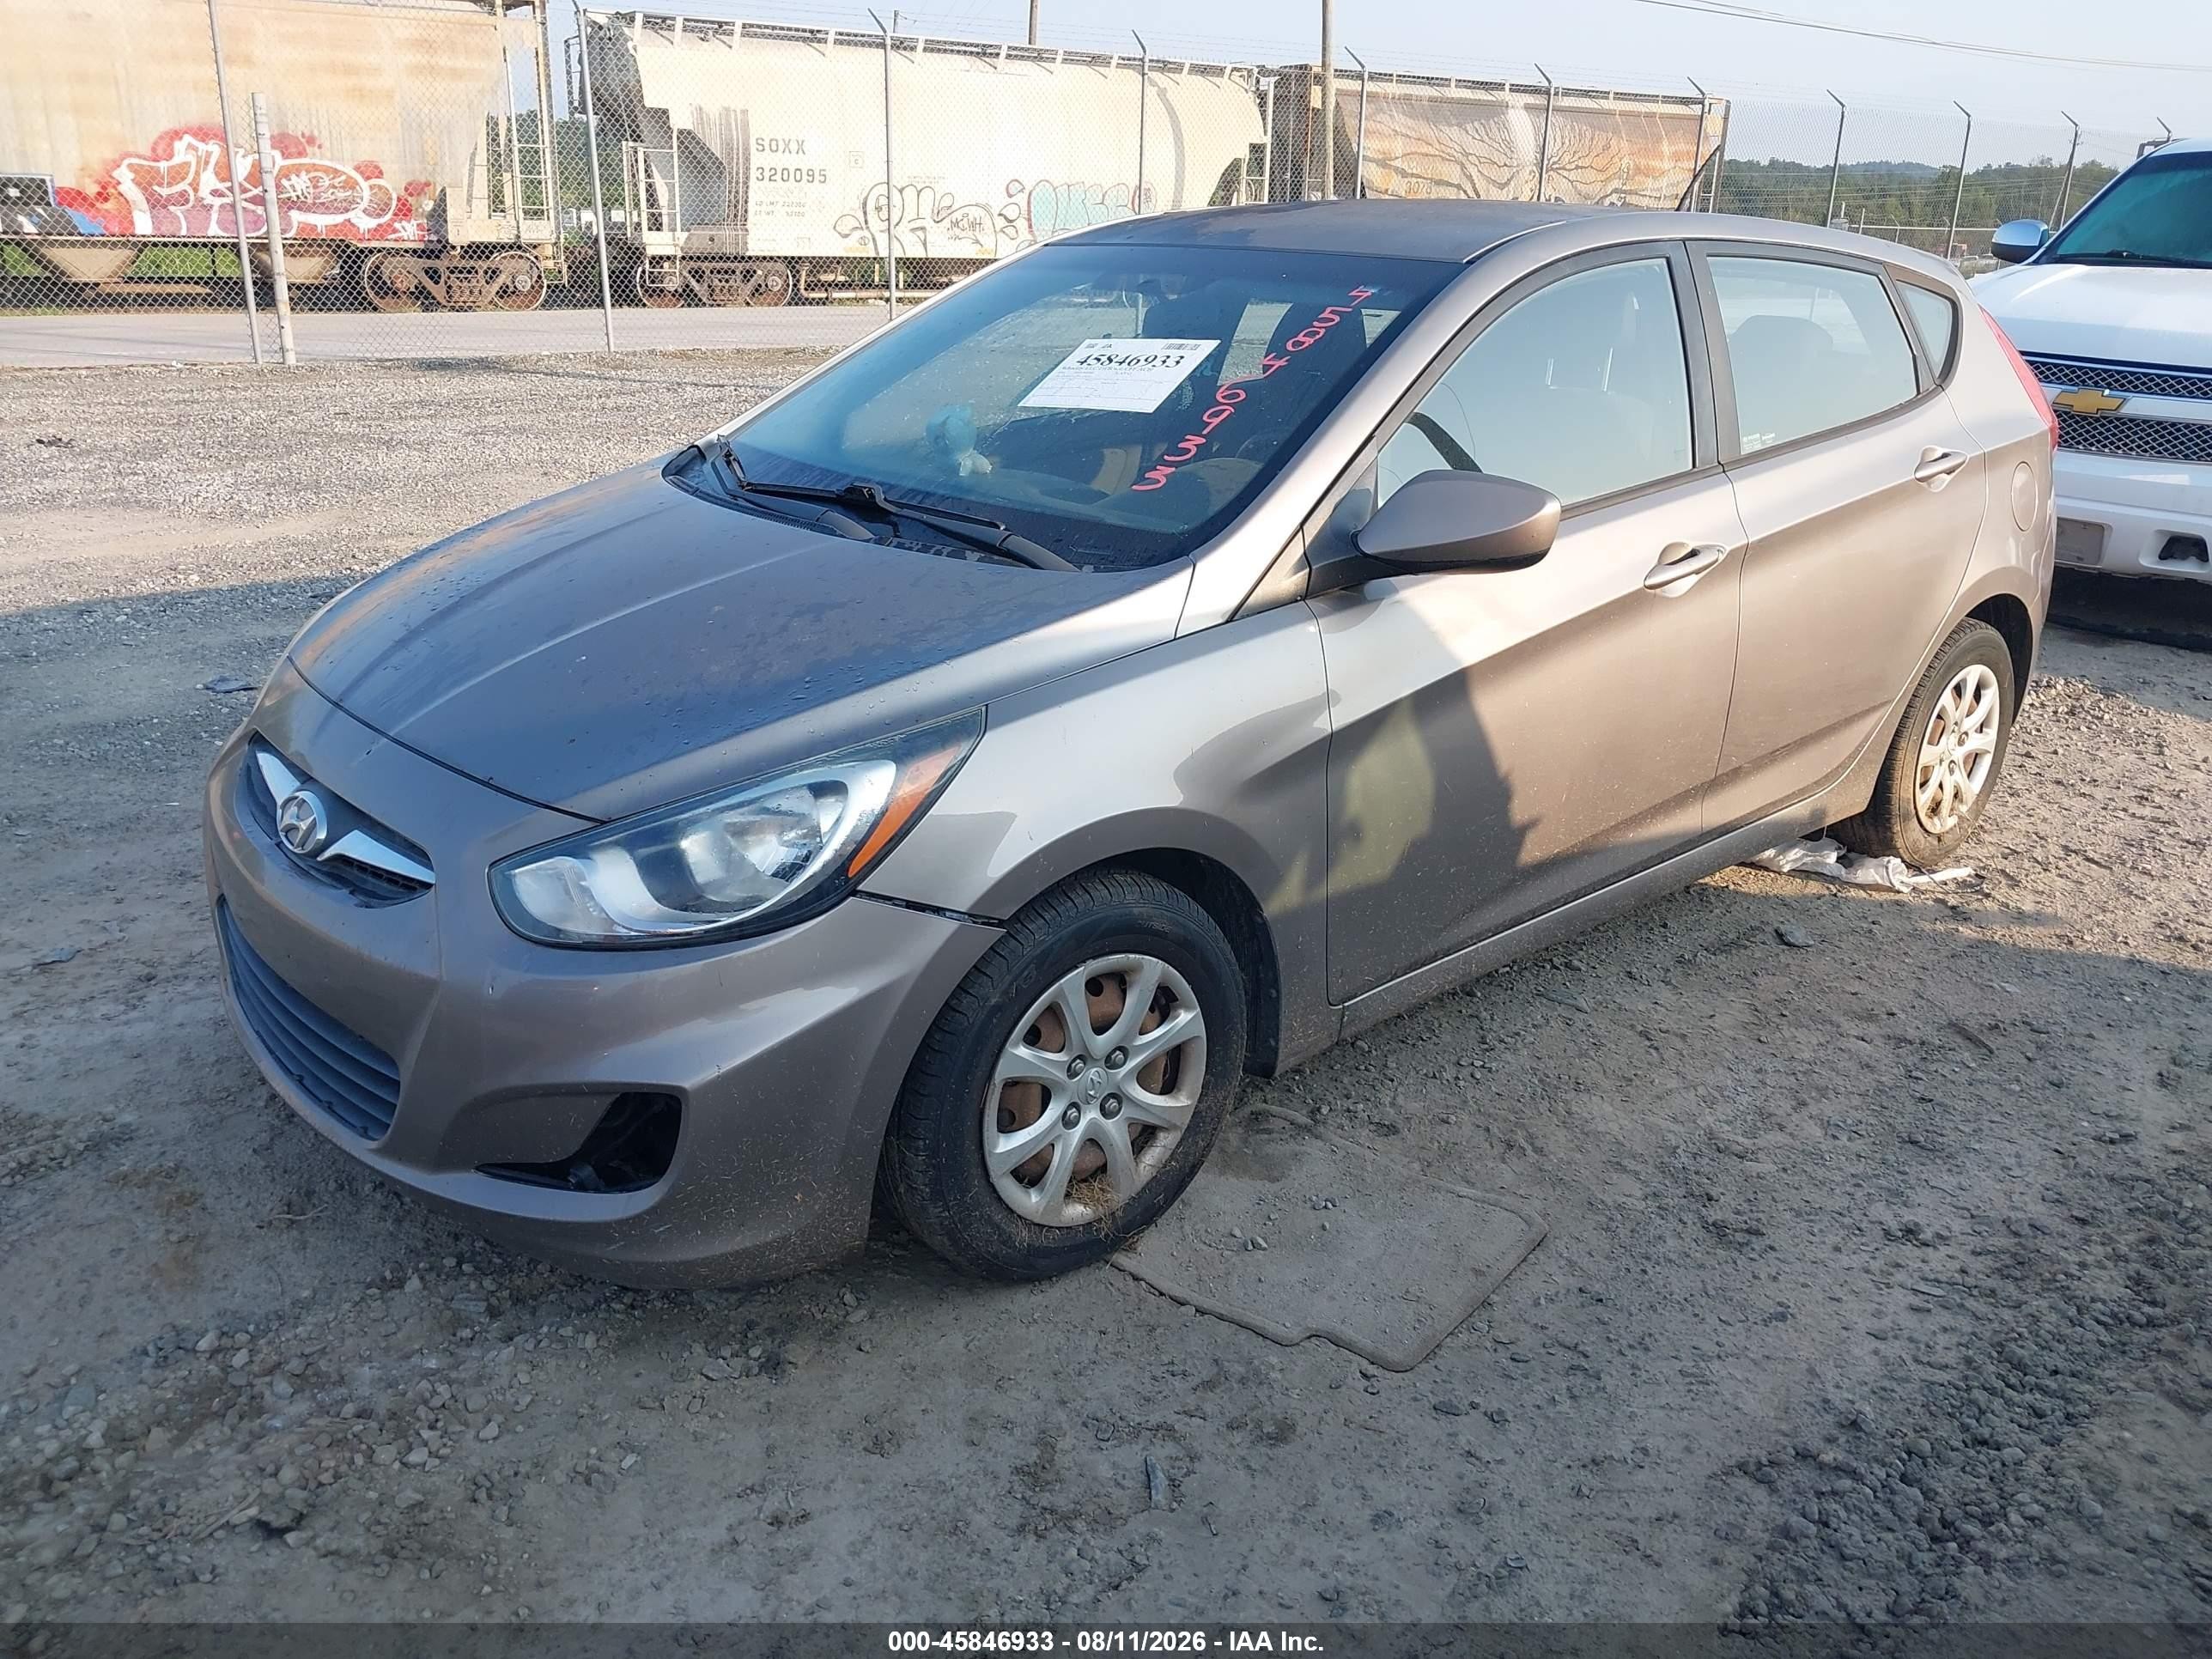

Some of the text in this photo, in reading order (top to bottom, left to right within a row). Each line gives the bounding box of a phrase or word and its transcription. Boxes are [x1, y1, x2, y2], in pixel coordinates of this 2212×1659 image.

[755, 137, 806, 155] SOXX
[756, 167, 827, 184] 320095
[1076, 353, 1185, 368] 45846933
[1131, 285, 1372, 491] 45846933
